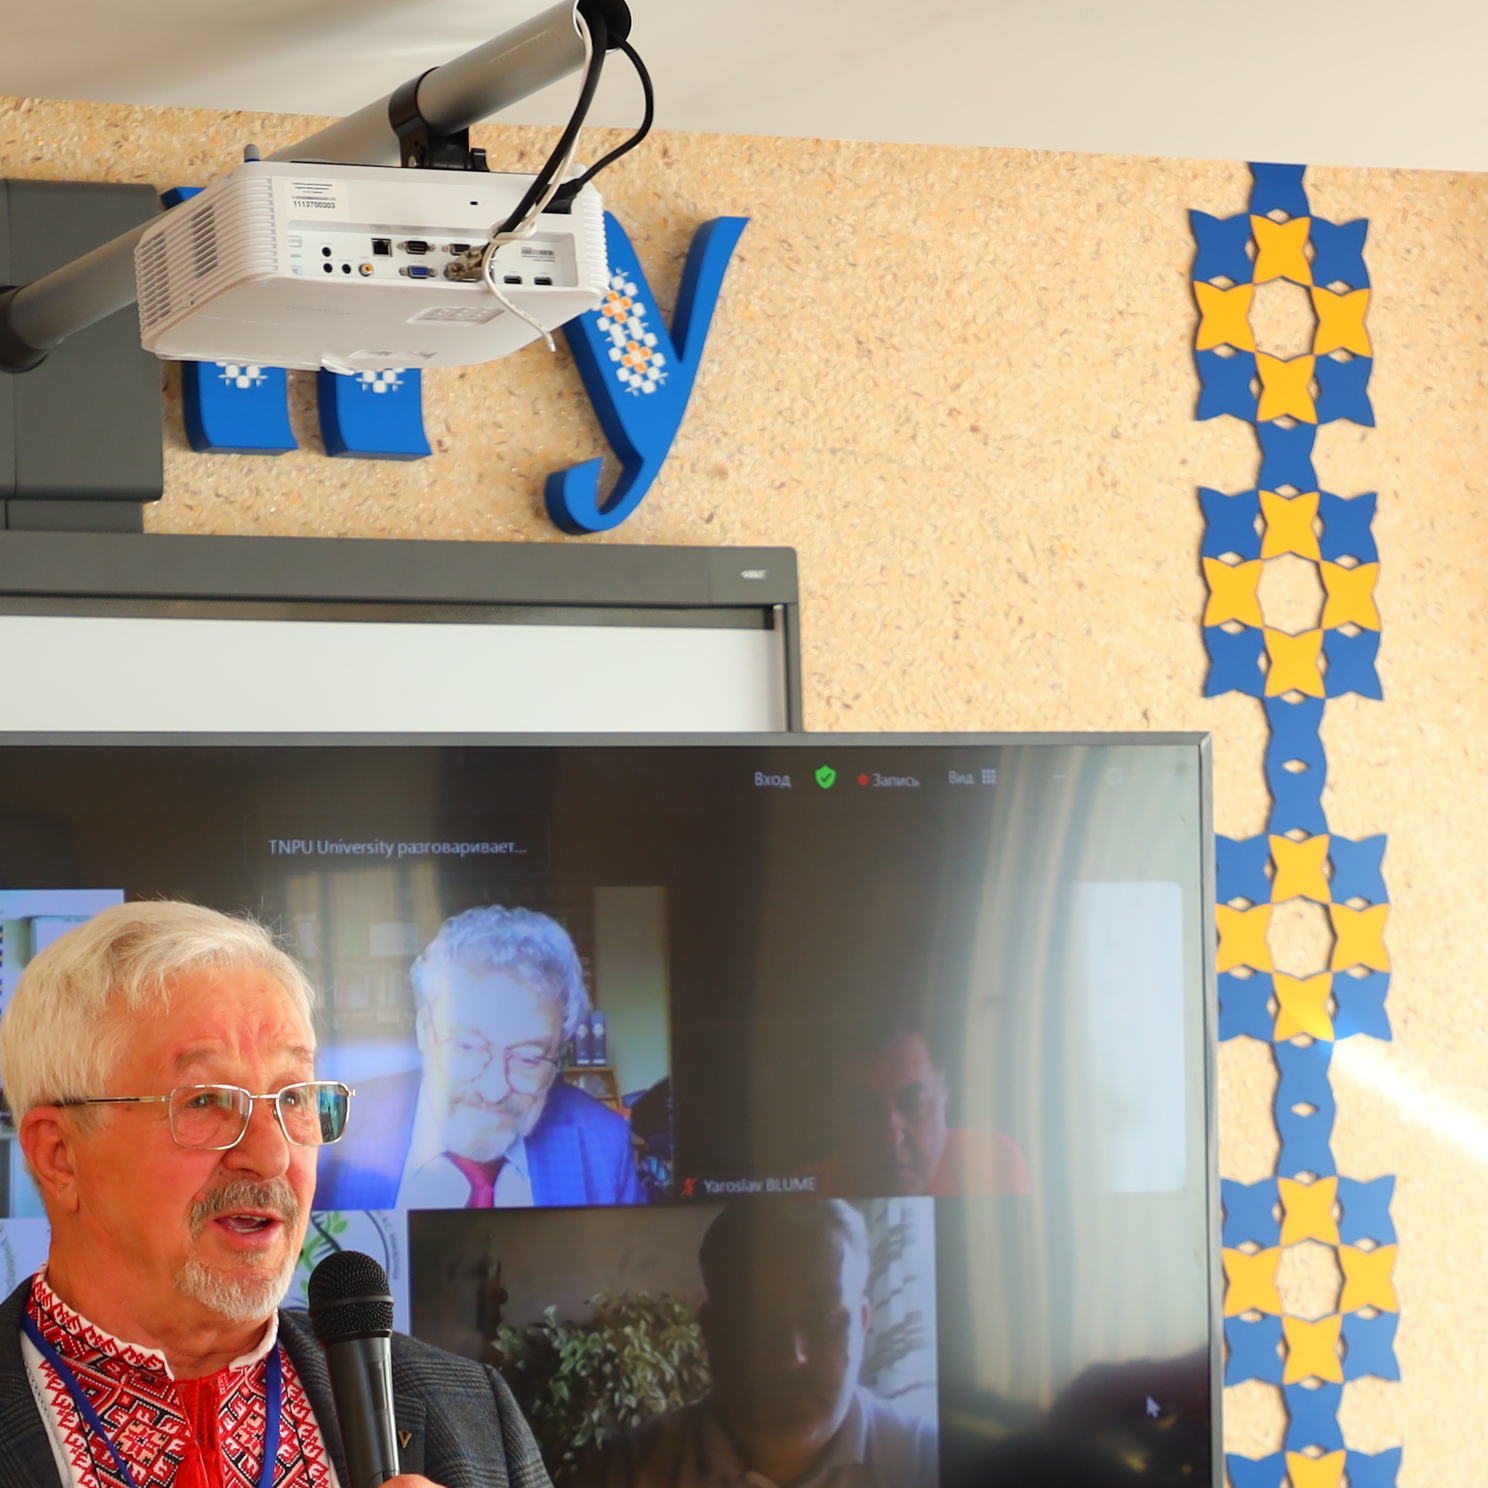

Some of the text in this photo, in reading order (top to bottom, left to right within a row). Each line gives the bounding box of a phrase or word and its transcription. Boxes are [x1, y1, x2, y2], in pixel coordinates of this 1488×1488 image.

[754, 771, 792, 789] Вход
[872, 773, 920, 788] Запись
[948, 770, 974, 785] Вид
[268, 839, 312, 854] TNPU
[316, 838, 394, 858] University
[703, 1176, 816, 1194] Yaroslav BLUME
